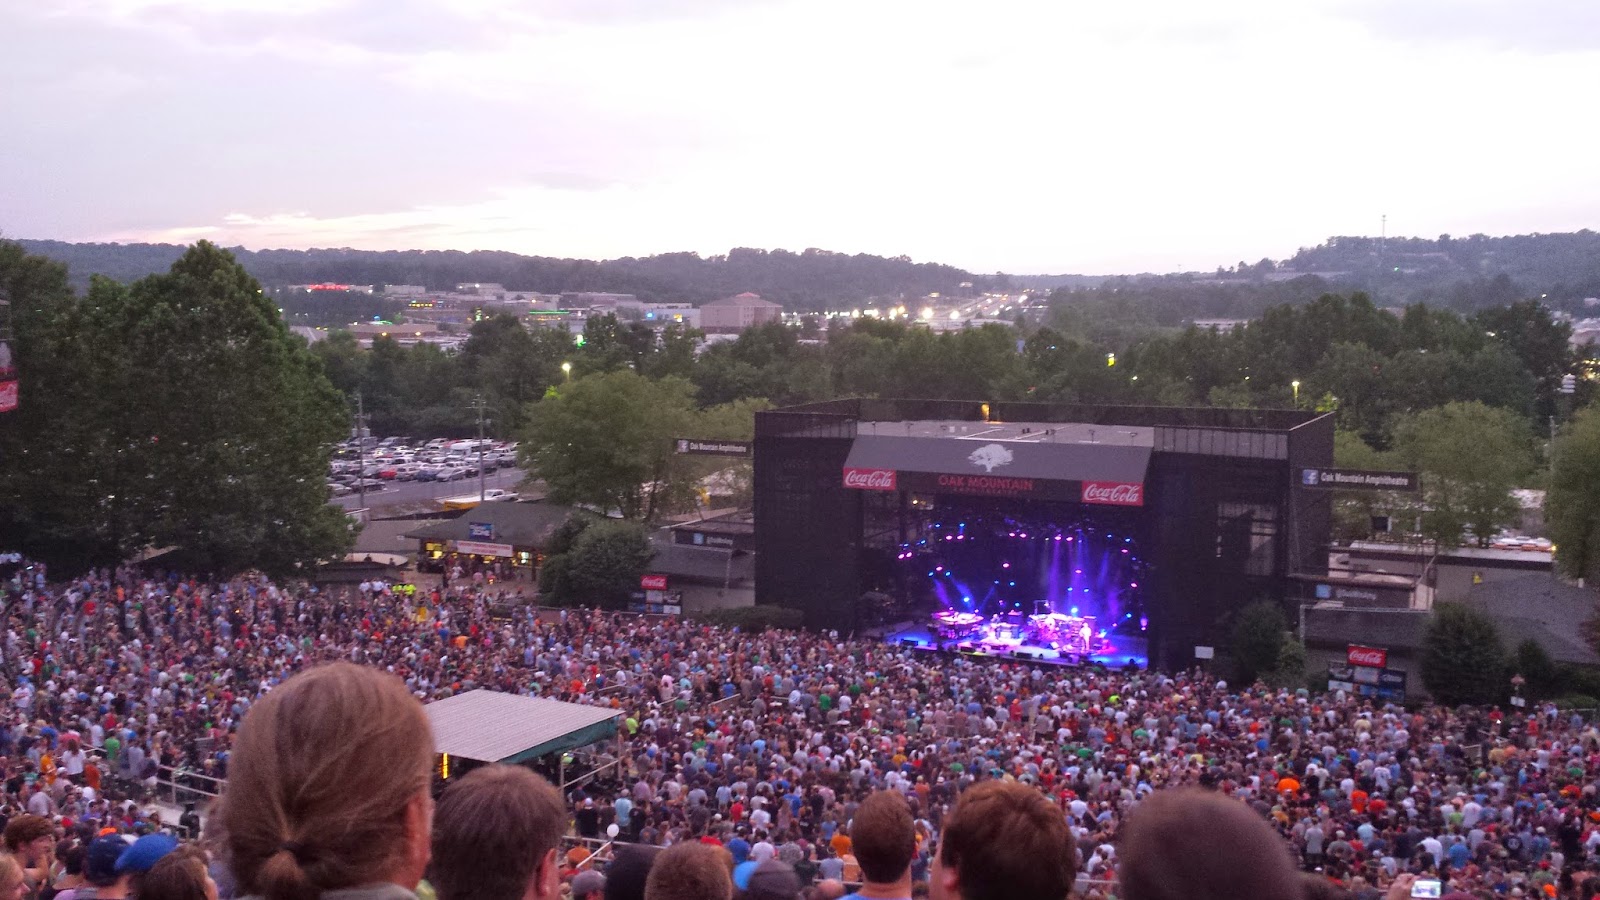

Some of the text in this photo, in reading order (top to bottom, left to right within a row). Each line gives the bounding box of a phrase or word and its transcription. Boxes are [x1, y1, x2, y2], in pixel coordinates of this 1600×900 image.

[845, 470, 894, 487] Coca-Cola
[939, 475, 1034, 490] OAK MOUNTAIN
[1321, 472, 1334, 482] Oak
[1335, 473, 1364, 483] Mountain
[1084, 483, 1140, 502] Coca-Cola
